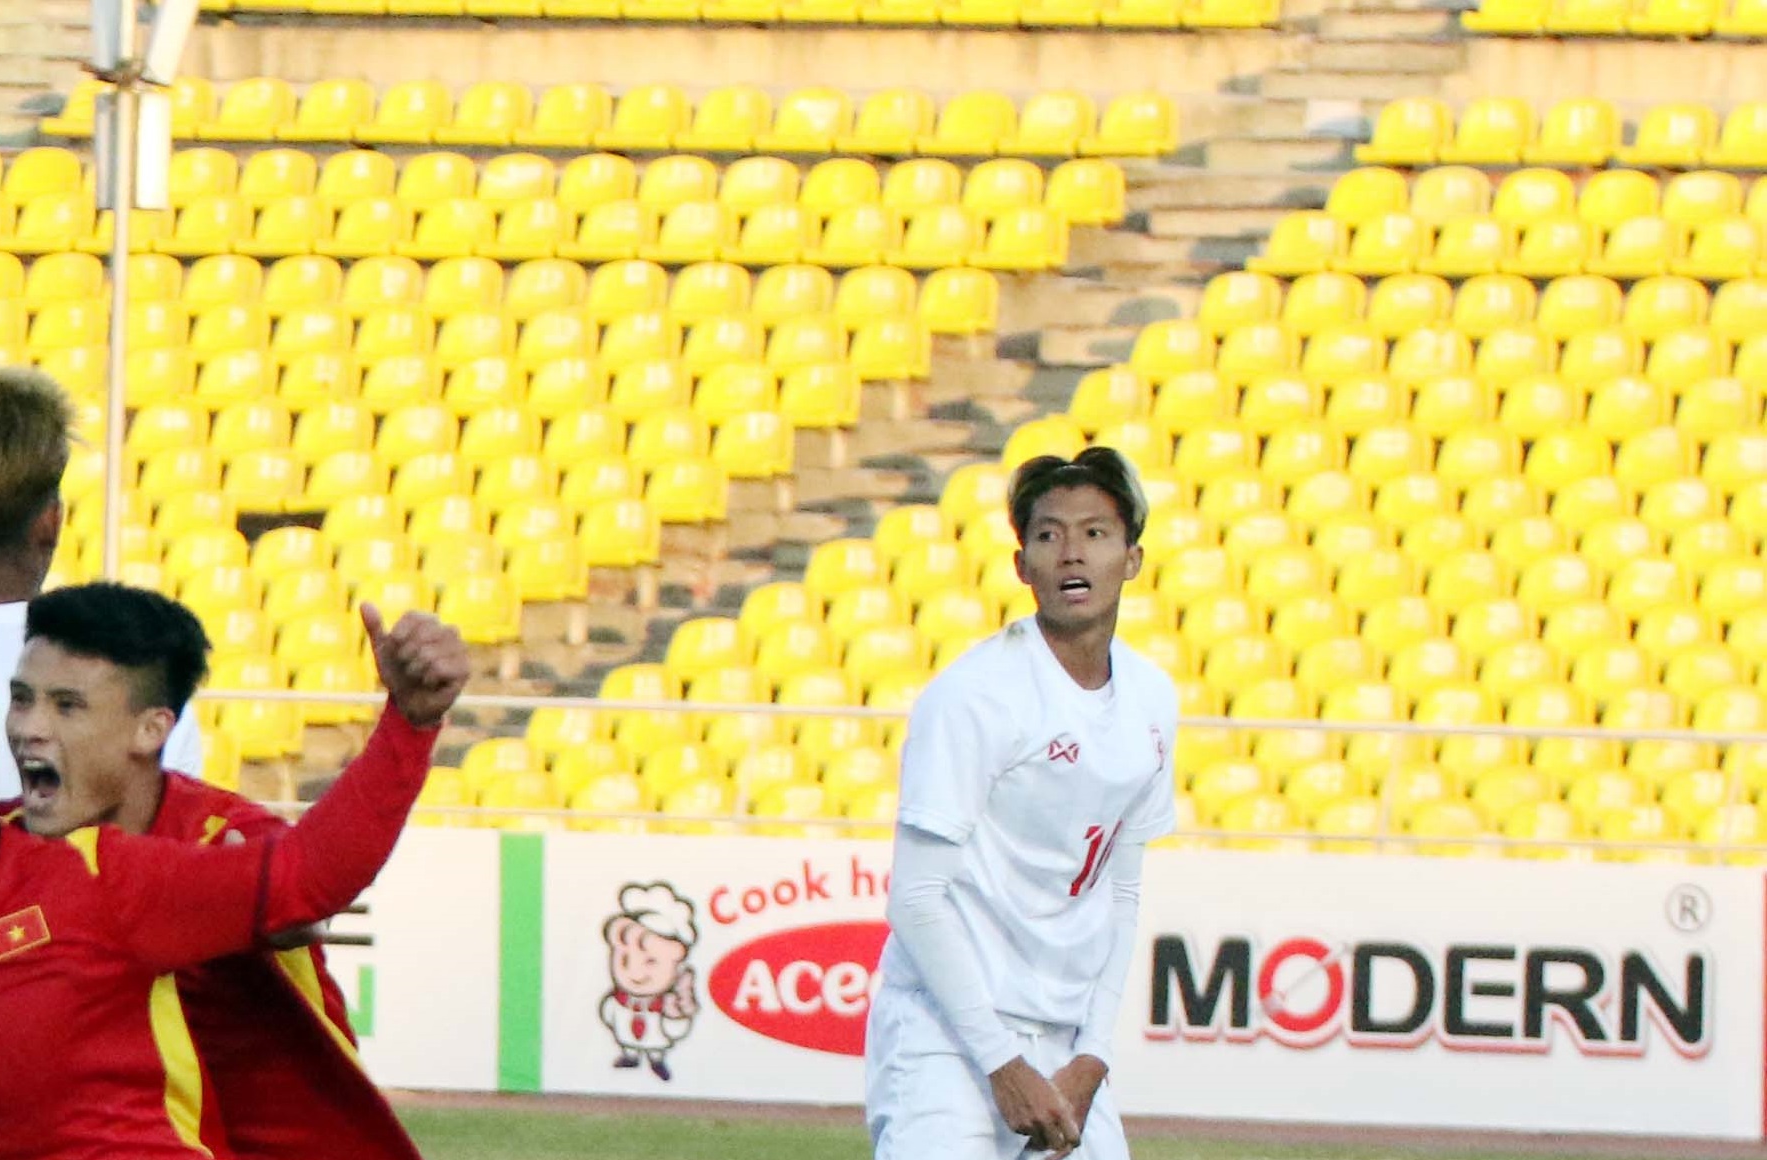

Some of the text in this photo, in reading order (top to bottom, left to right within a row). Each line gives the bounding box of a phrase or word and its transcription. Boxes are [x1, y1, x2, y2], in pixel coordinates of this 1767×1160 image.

[708, 859, 832, 925] Cook
[732, 958, 883, 1017] Ace
[1146, 932, 1711, 1054] MODERN
